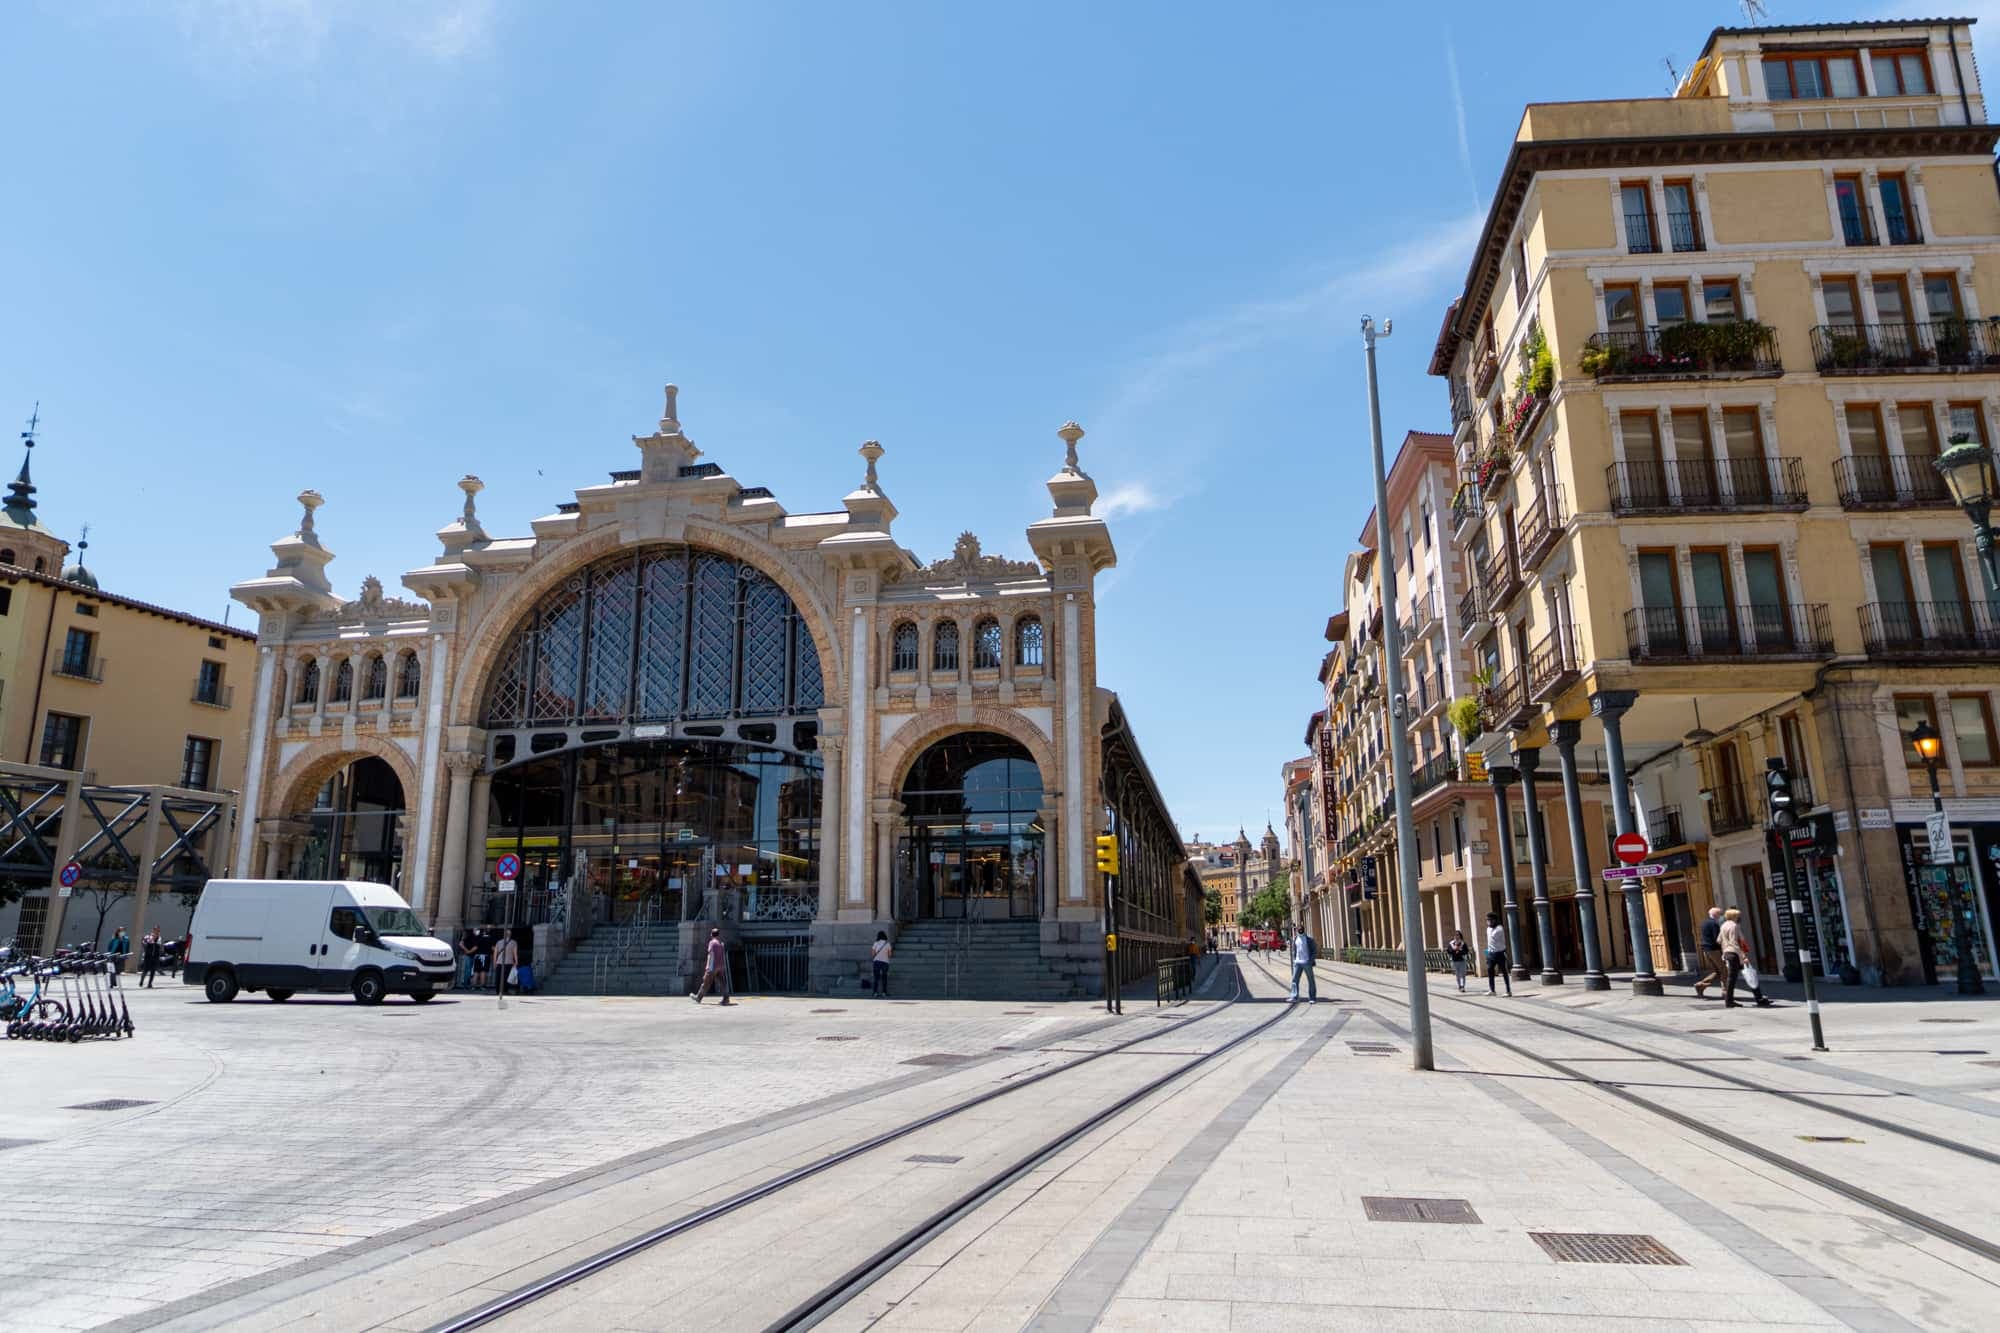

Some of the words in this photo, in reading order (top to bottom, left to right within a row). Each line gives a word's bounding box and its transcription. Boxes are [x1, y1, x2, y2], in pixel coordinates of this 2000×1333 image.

[1322, 732, 1332, 770] HOTEL
[1325, 778, 1336, 840] HISPANIA
[1932, 829, 1945, 842] 20
